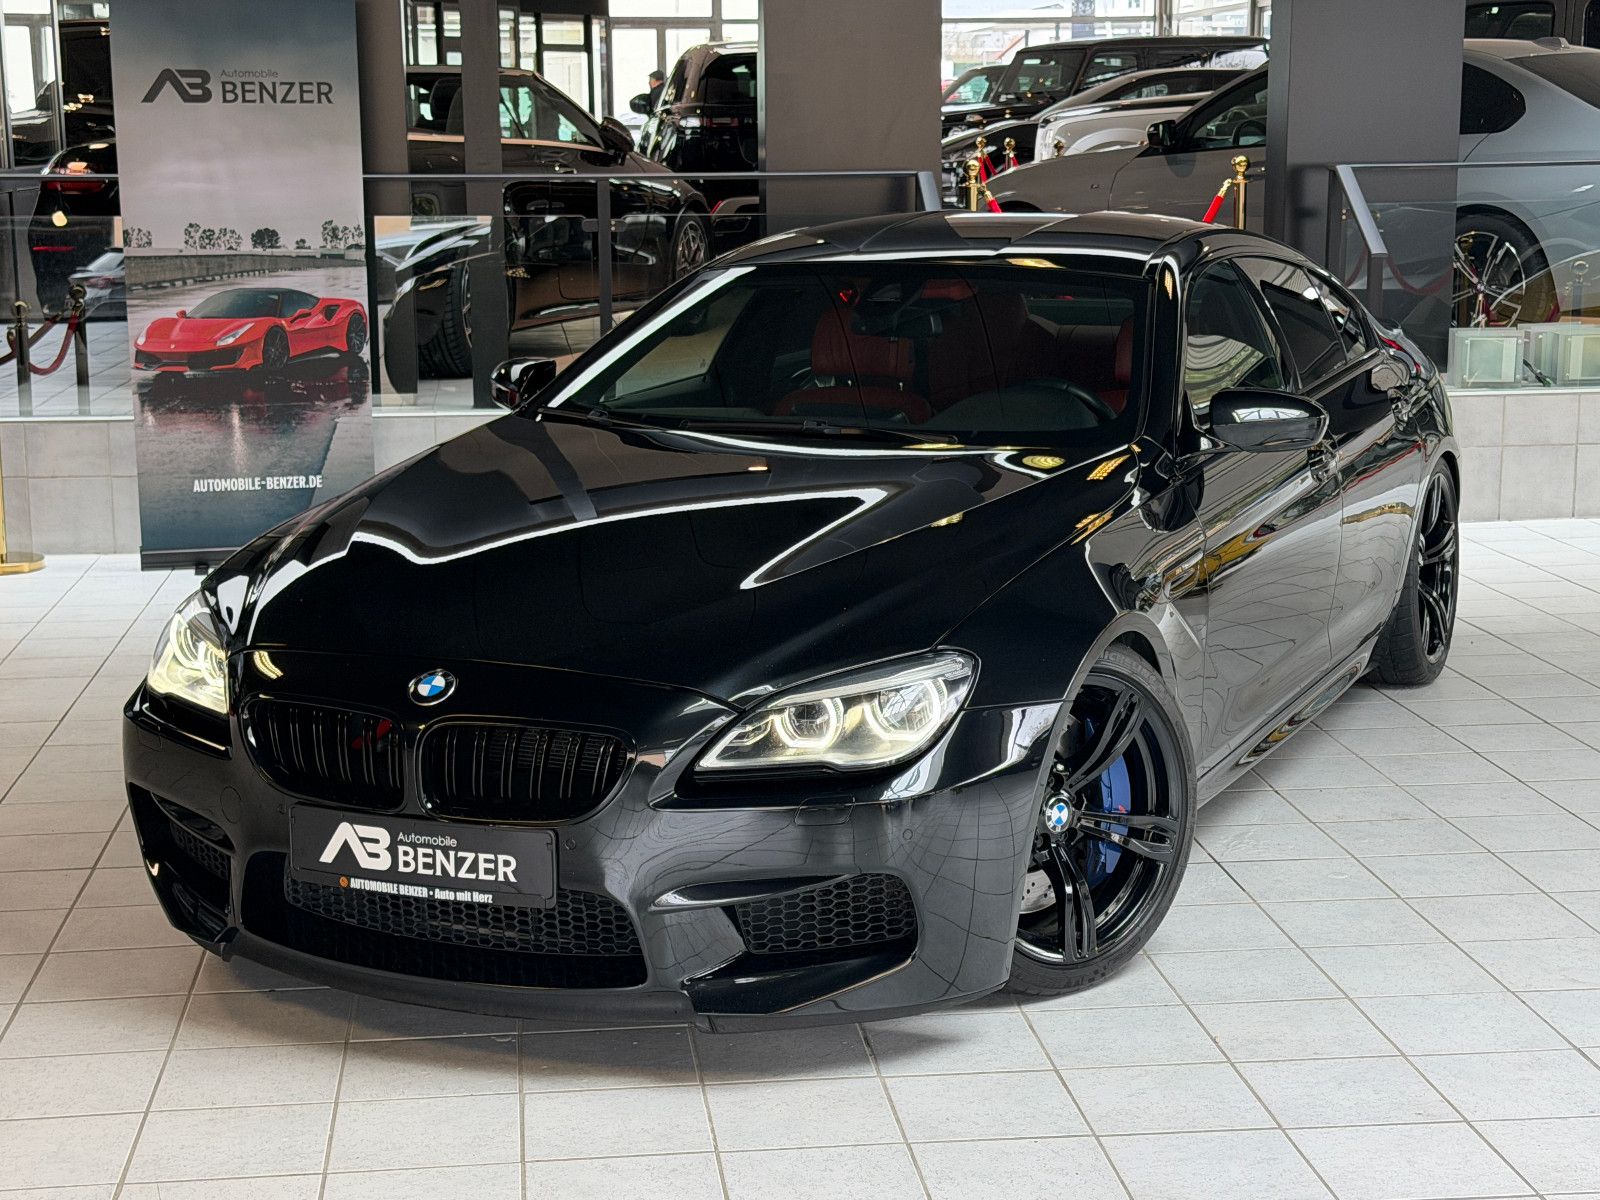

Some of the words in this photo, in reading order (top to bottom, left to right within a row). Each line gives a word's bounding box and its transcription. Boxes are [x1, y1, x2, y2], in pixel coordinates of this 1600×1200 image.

[220, 69, 279, 79] Automobile
[220, 81, 334, 104] BENZER
[193, 475, 323, 492] AUTOMOBILE-BENZER.DE
[397, 832, 457, 847] Automobile
[397, 845, 518, 883] BENZER
[350, 877, 398, 894] AUTOMOBILE
[399, 884, 428, 898] BENZER
[434, 888, 455, 901] Auto
[456, 891, 472, 902] mit
[472, 891, 493, 904] Herz
